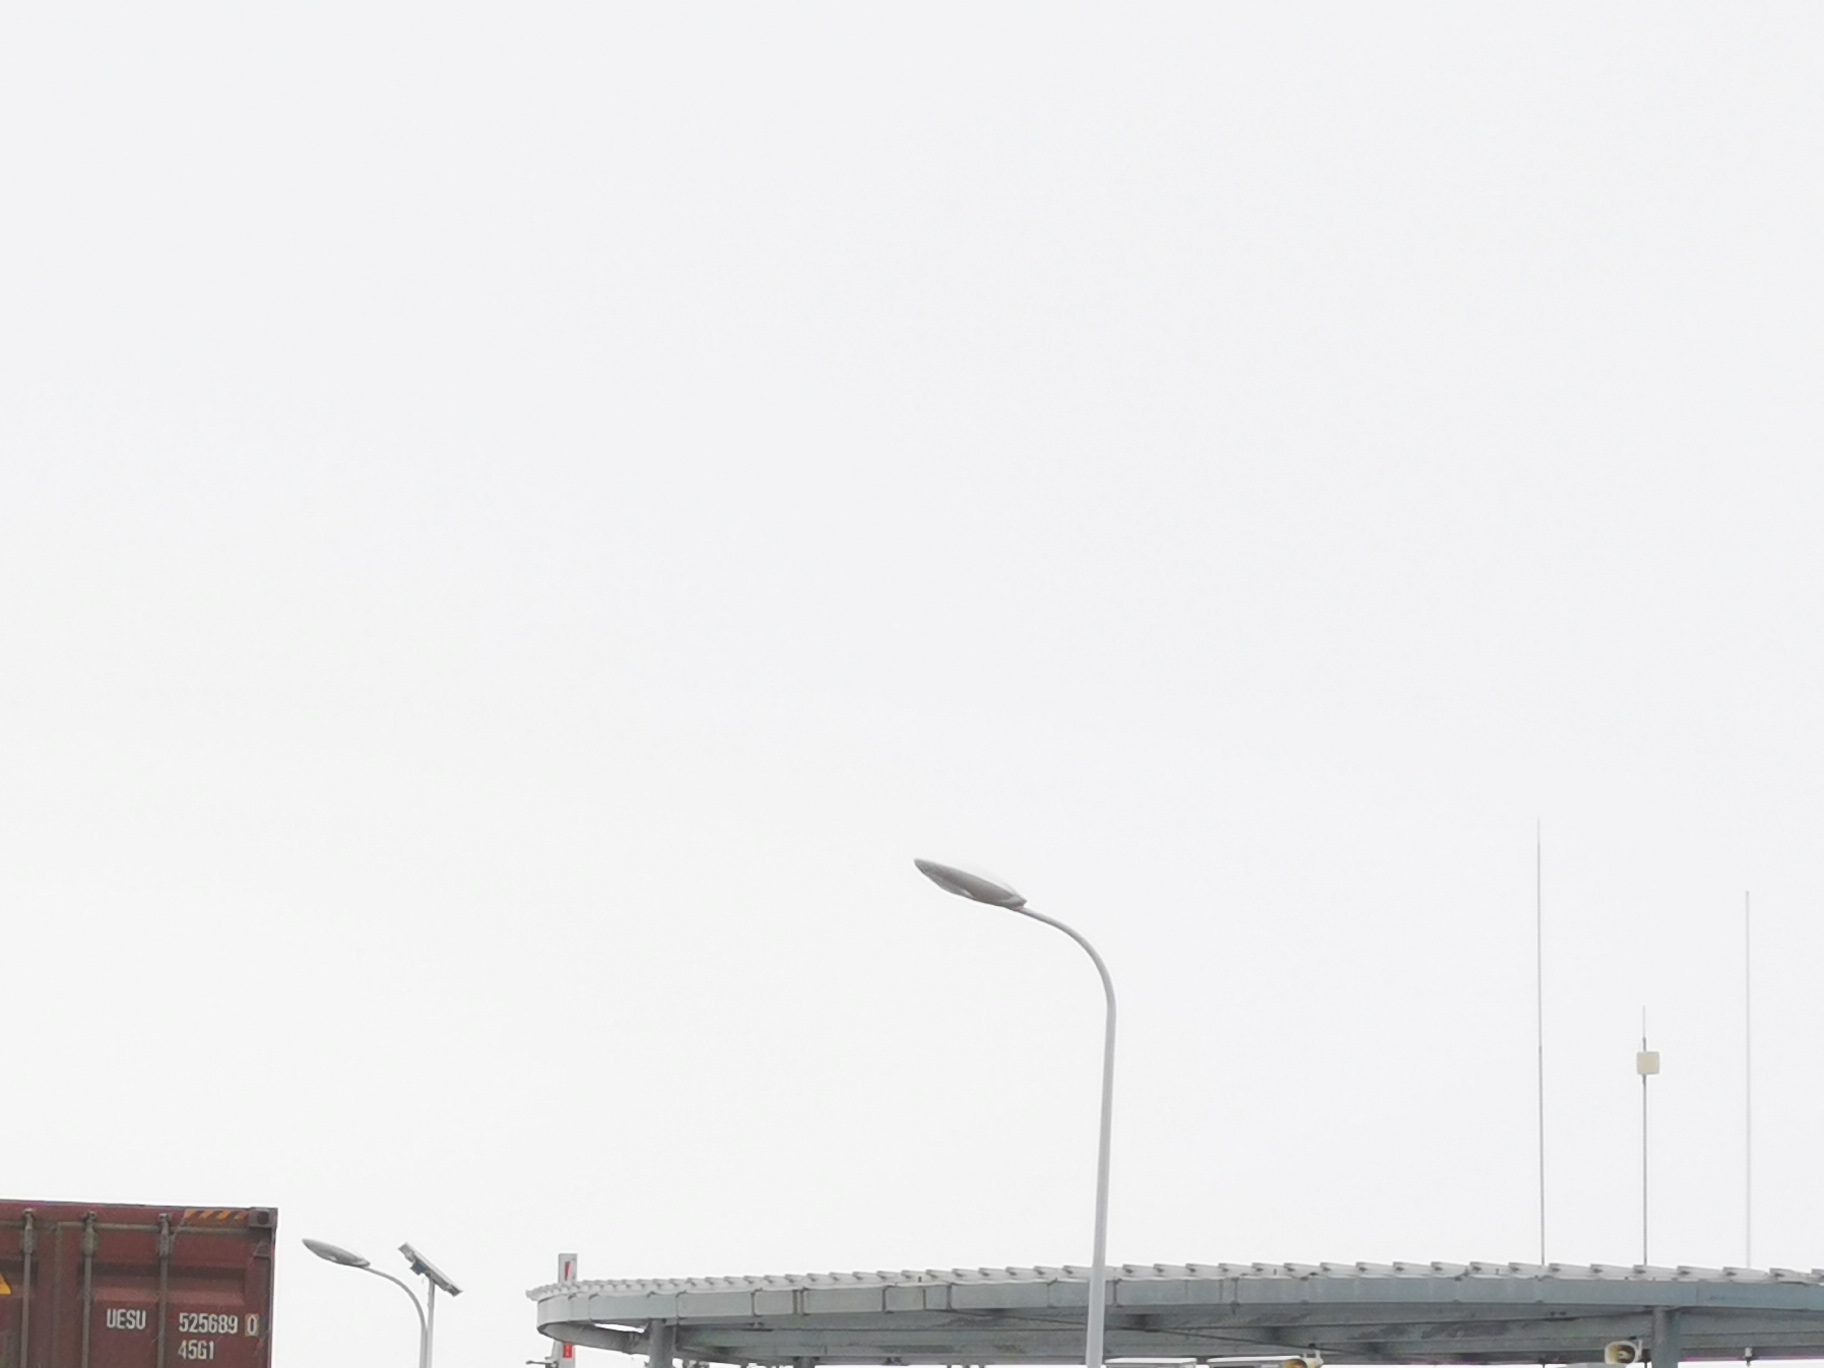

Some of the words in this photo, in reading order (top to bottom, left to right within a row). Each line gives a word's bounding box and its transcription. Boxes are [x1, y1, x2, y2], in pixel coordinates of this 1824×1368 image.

[106, 1308, 146, 1330] UESU
[178, 1312, 238, 1333] 525689
[246, 1315, 258, 1336] 0
[177, 1339, 214, 1360] 45G1
